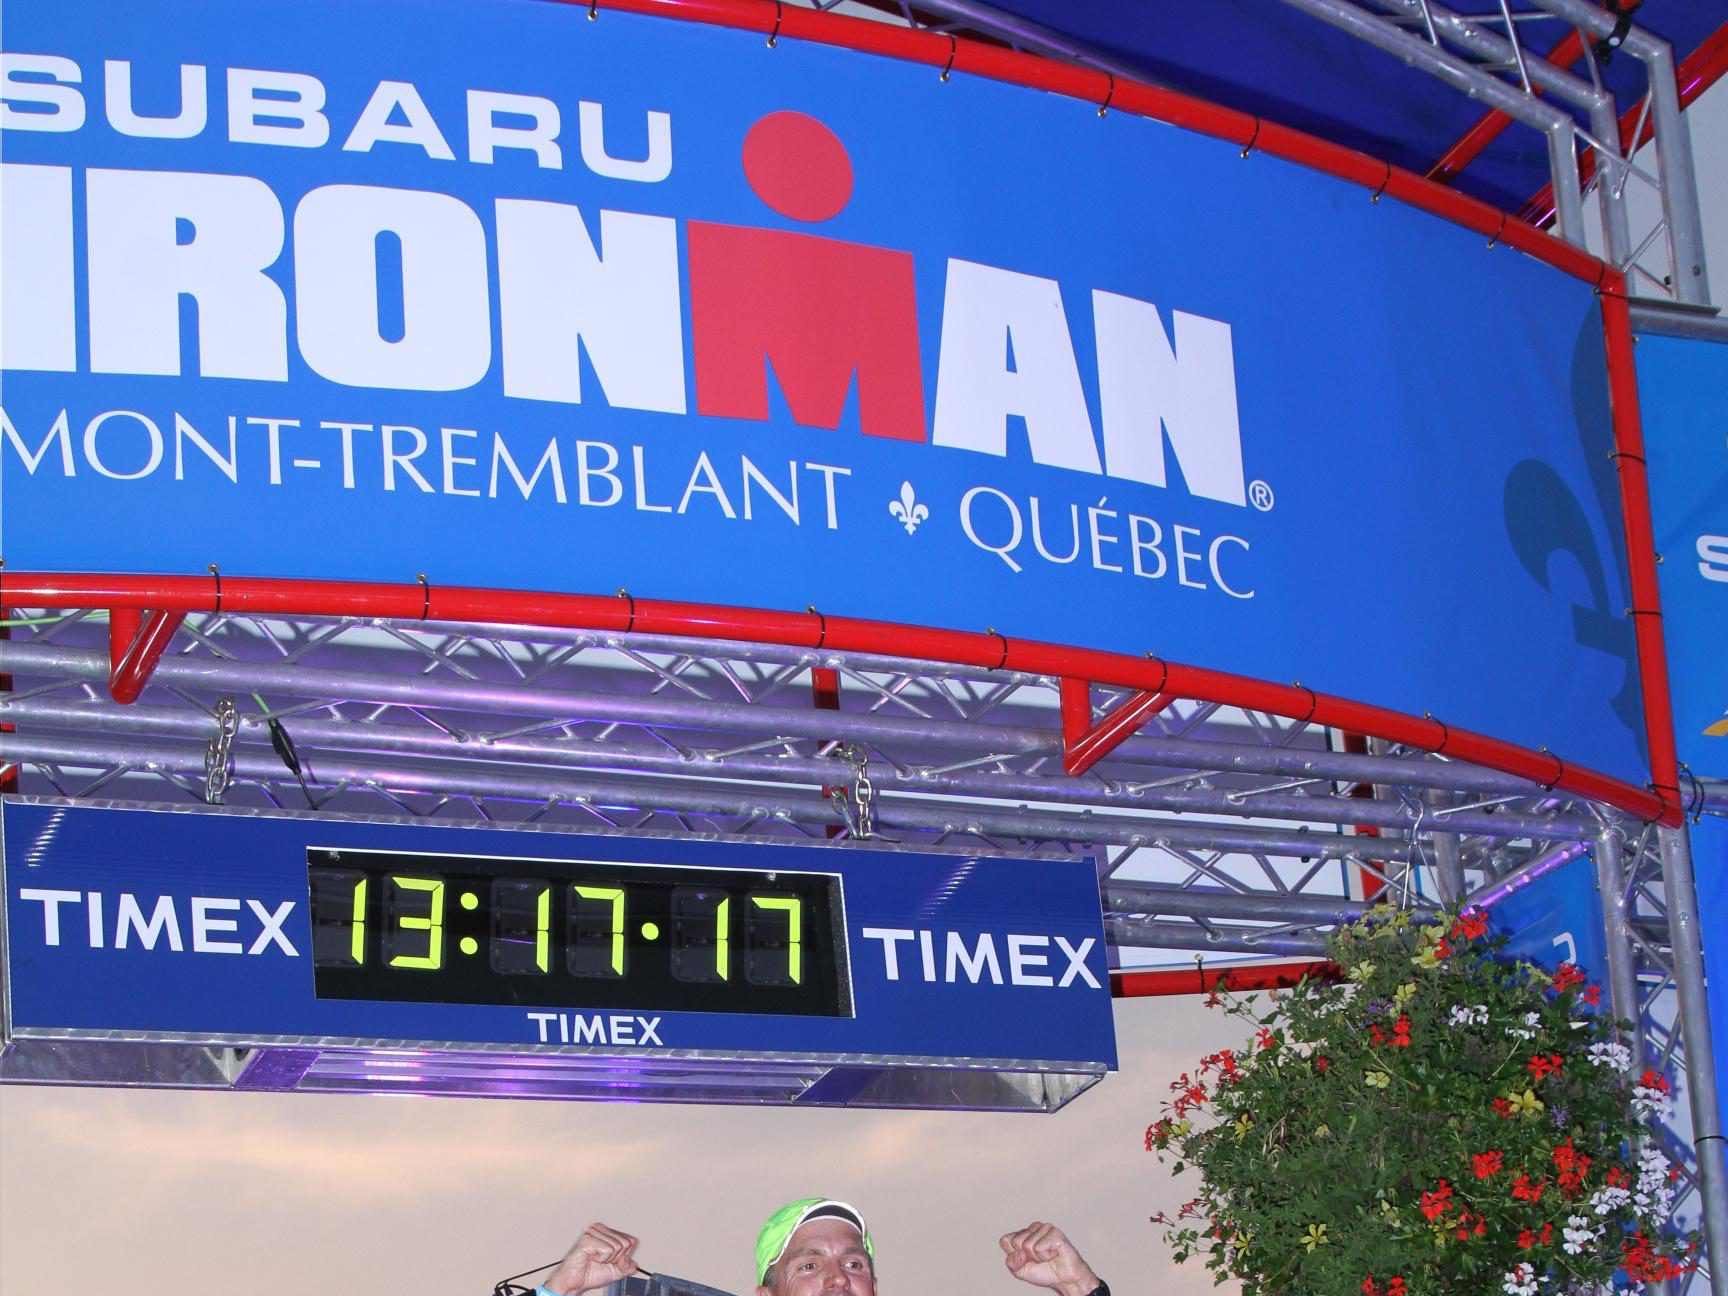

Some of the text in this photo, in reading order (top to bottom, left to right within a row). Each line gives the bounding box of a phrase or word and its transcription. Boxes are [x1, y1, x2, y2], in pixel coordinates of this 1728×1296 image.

[0, 52, 674, 184] SUBARU
[0, 110, 1247, 507] IRONMAN
[0, 407, 1255, 599] MONT-TREMBLANT QUÉBEC
[20, 887, 300, 957] TIMEX
[862, 927, 1102, 989] TIMEX
[527, 1012, 664, 1046] TIMEX
